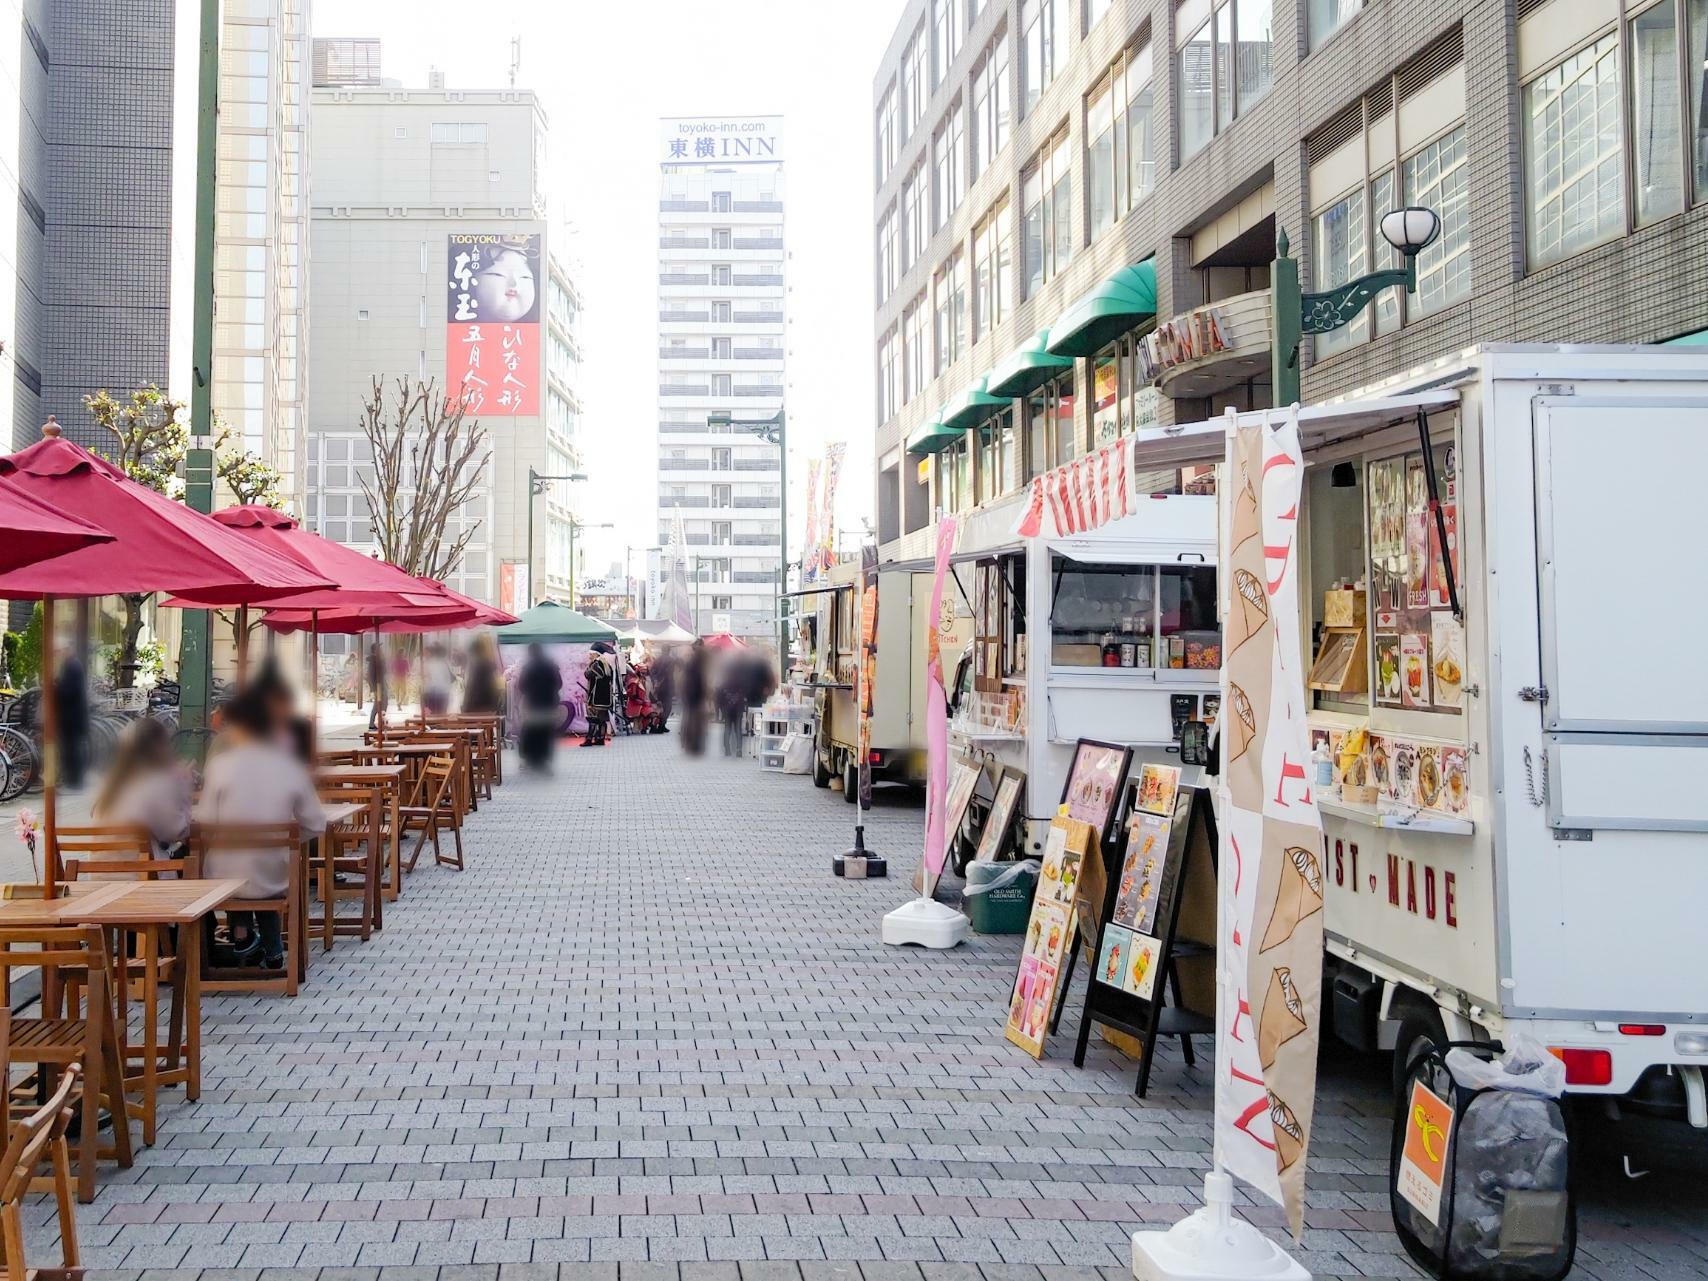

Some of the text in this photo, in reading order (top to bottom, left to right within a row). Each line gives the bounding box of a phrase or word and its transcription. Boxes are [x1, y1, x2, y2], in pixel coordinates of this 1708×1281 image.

[679, 121, 765, 134] toyoko-inn.com
[450, 235, 500, 244] TOGYOKU
[471, 245, 480, 270] 人形の
[1408, 591, 1427, 602] FRESH
[1387, 853, 1457, 928] MADE
